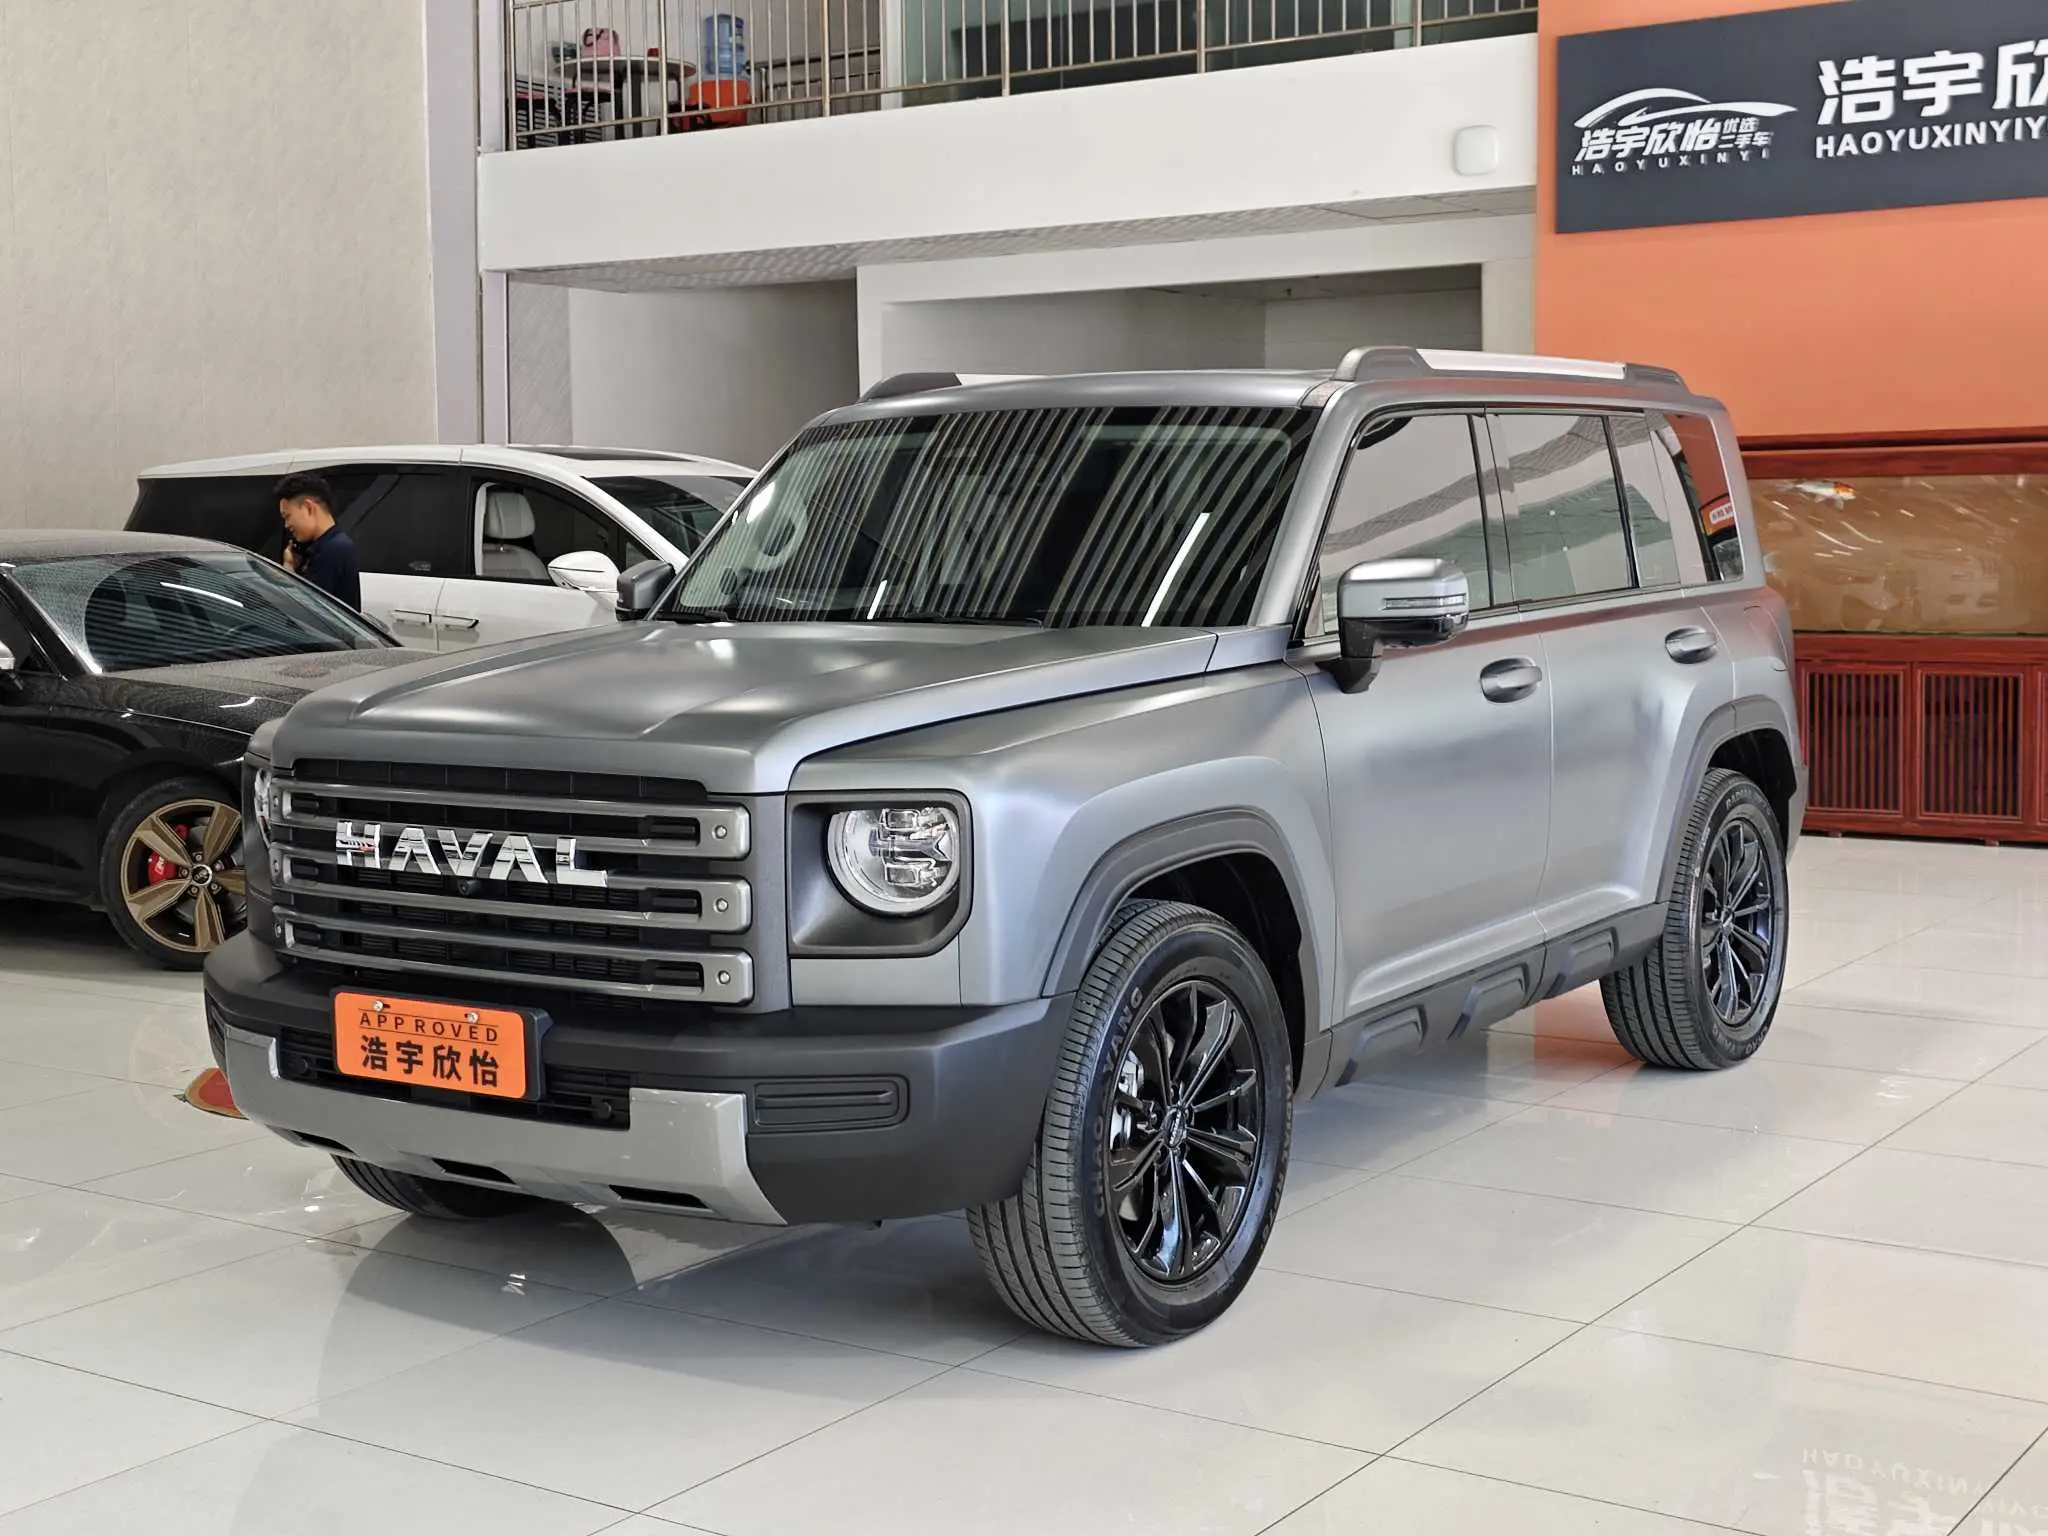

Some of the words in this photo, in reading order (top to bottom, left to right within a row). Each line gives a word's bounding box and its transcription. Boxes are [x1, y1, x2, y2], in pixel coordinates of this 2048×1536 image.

[1574, 117, 1722, 162] 浩宇欣怡
[1717, 131, 1772, 149] 二手车
[1572, 147, 1769, 176] HAOYUXINYI
[336, 821, 608, 887] HAVAL
[360, 1012, 498, 1042] APPROVED
[361, 1034, 499, 1087] 浩宇欣怡
